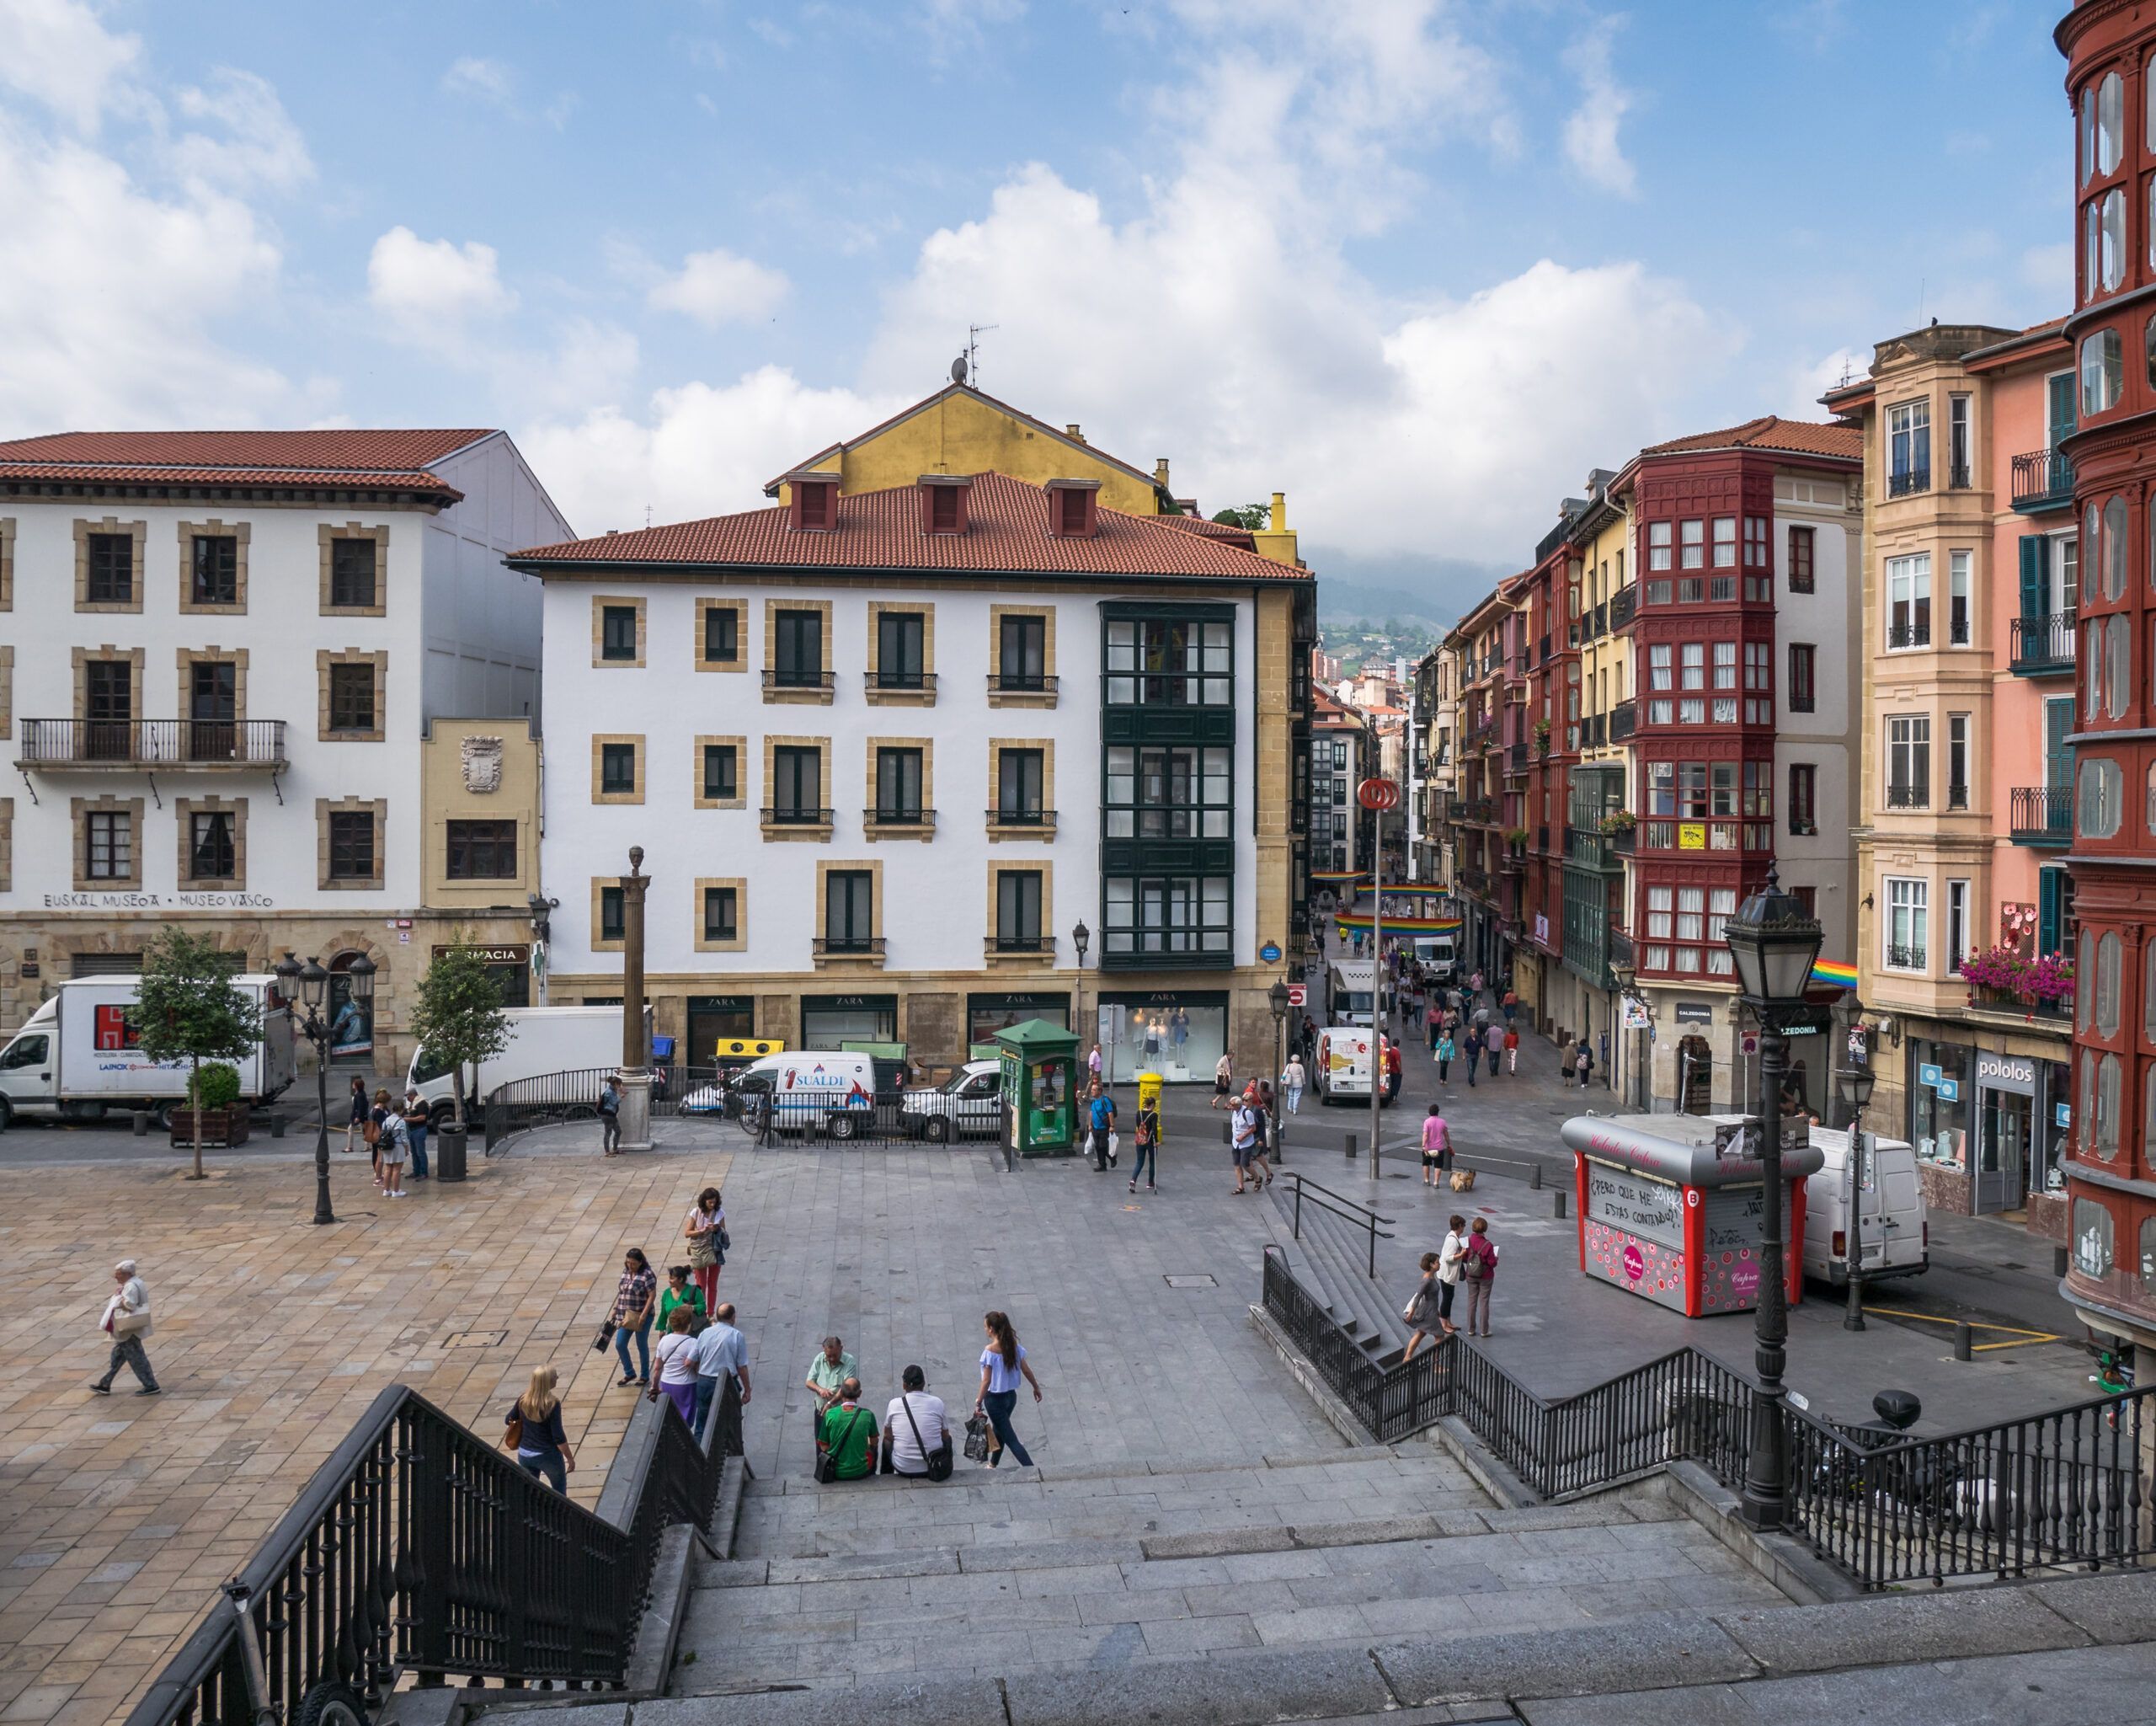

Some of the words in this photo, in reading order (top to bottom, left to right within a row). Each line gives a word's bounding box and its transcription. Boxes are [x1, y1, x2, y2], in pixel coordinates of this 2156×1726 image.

[44, 894, 98, 907] EUSKAL
[103, 894, 159, 907] MUSEOA
[179, 894, 226, 907] MUSEO
[231, 894, 273, 907] VASCO
[446, 950, 516, 959] FRMACIA
[1781, 1026, 1817, 1036] LZEDONIA
[1979, 1059, 2032, 1082] pololos
[796, 1075, 843, 1086] SUALDI
[1618, 1185, 1636, 1200] QUE
[1639, 1189, 1652, 1207] ME
[1689, 1193, 1697, 1204] B
[1605, 1202, 1629, 1219] ESTAS
